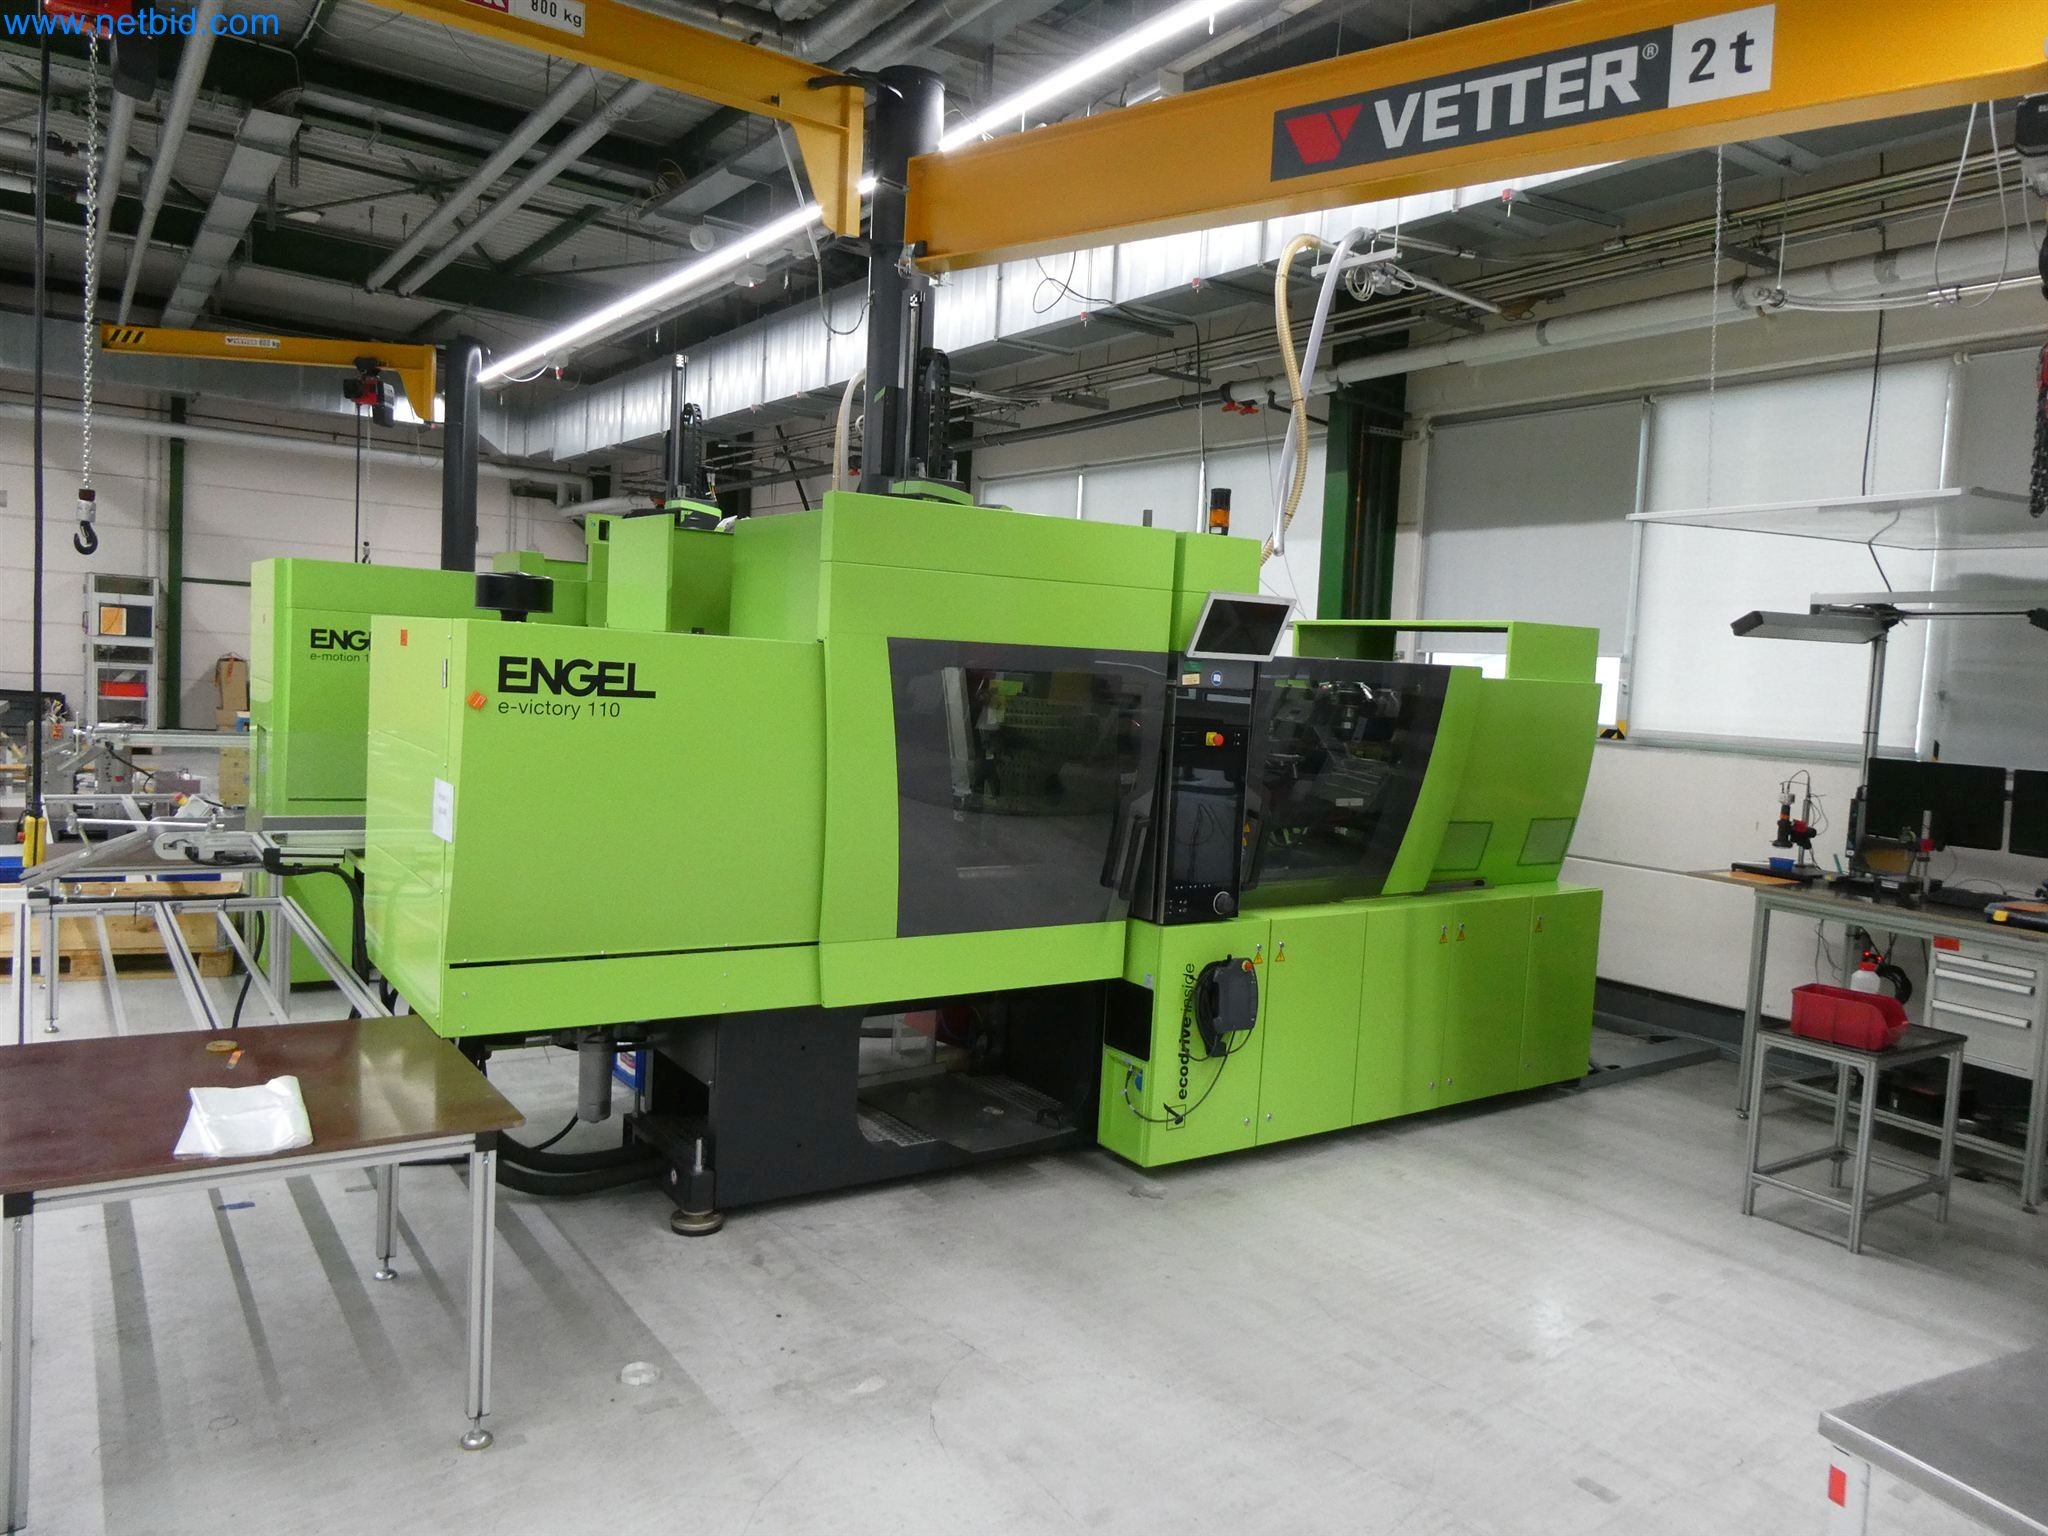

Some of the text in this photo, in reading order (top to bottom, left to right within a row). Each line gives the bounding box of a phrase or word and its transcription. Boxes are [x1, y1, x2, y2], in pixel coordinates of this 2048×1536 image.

[531, 0, 582, 27] 800 kg
[1689, 38, 1717, 83] 2
[1729, 30, 1755, 74] t
[310, 628, 371, 651] ENG
[310, 652, 360, 662] e-motion
[498, 656, 657, 699] ENGEL
[498, 699, 620, 720] e-victory 110
[1178, 1017, 1193, 1100] ecodrive
